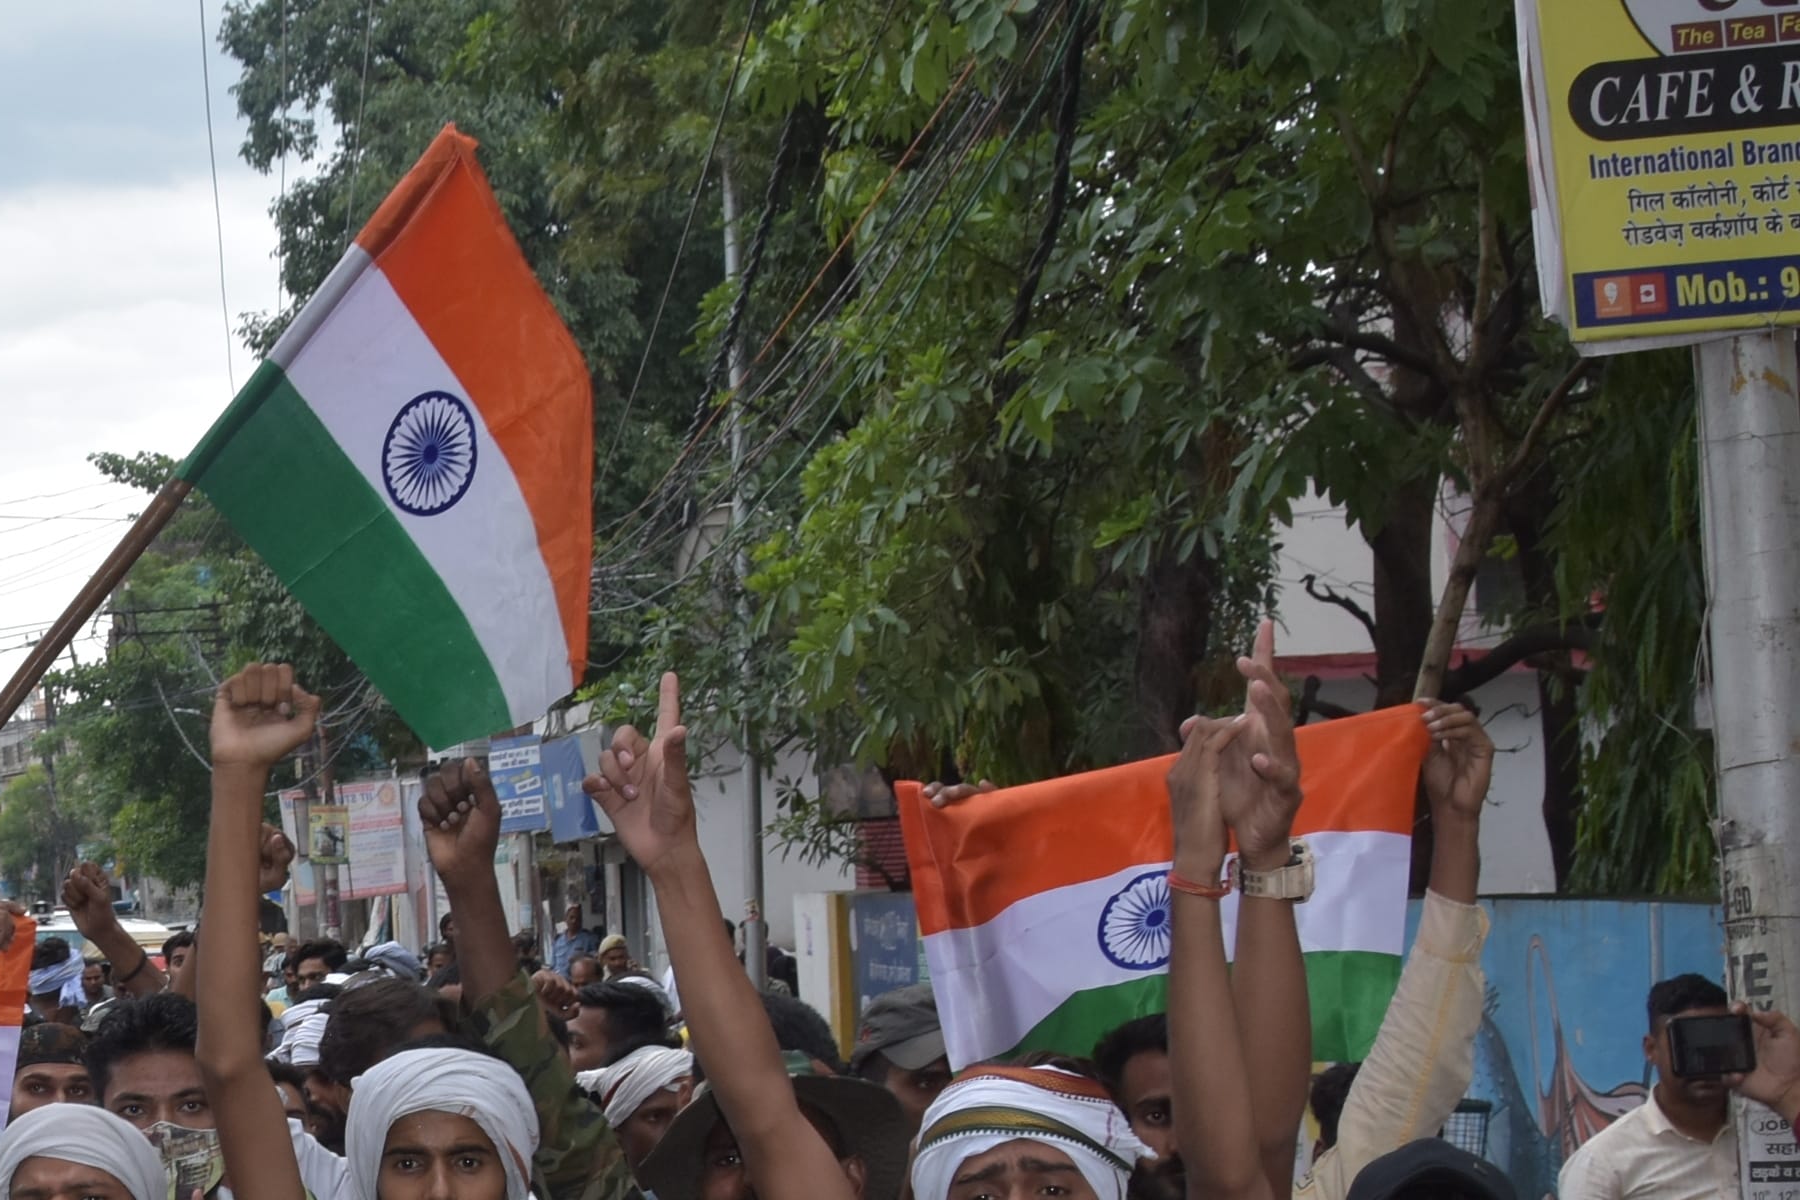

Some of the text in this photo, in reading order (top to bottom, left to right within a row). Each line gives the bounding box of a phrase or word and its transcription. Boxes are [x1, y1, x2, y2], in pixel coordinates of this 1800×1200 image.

[1676, 28, 1714, 47] The
[1730, 23, 1766, 41] Tea
[1589, 68, 1715, 127] CAFE
[1729, 64, 1764, 114] &
[1589, 142, 1734, 179] International
[1628, 188, 1665, 213] गिल
[1751, 174, 1790, 202] कोर्ट
[1689, 212, 1758, 239] वर्कशॉप
[1764, 208, 1783, 232] के
[1676, 266, 1800, 307] Mob.: 9
